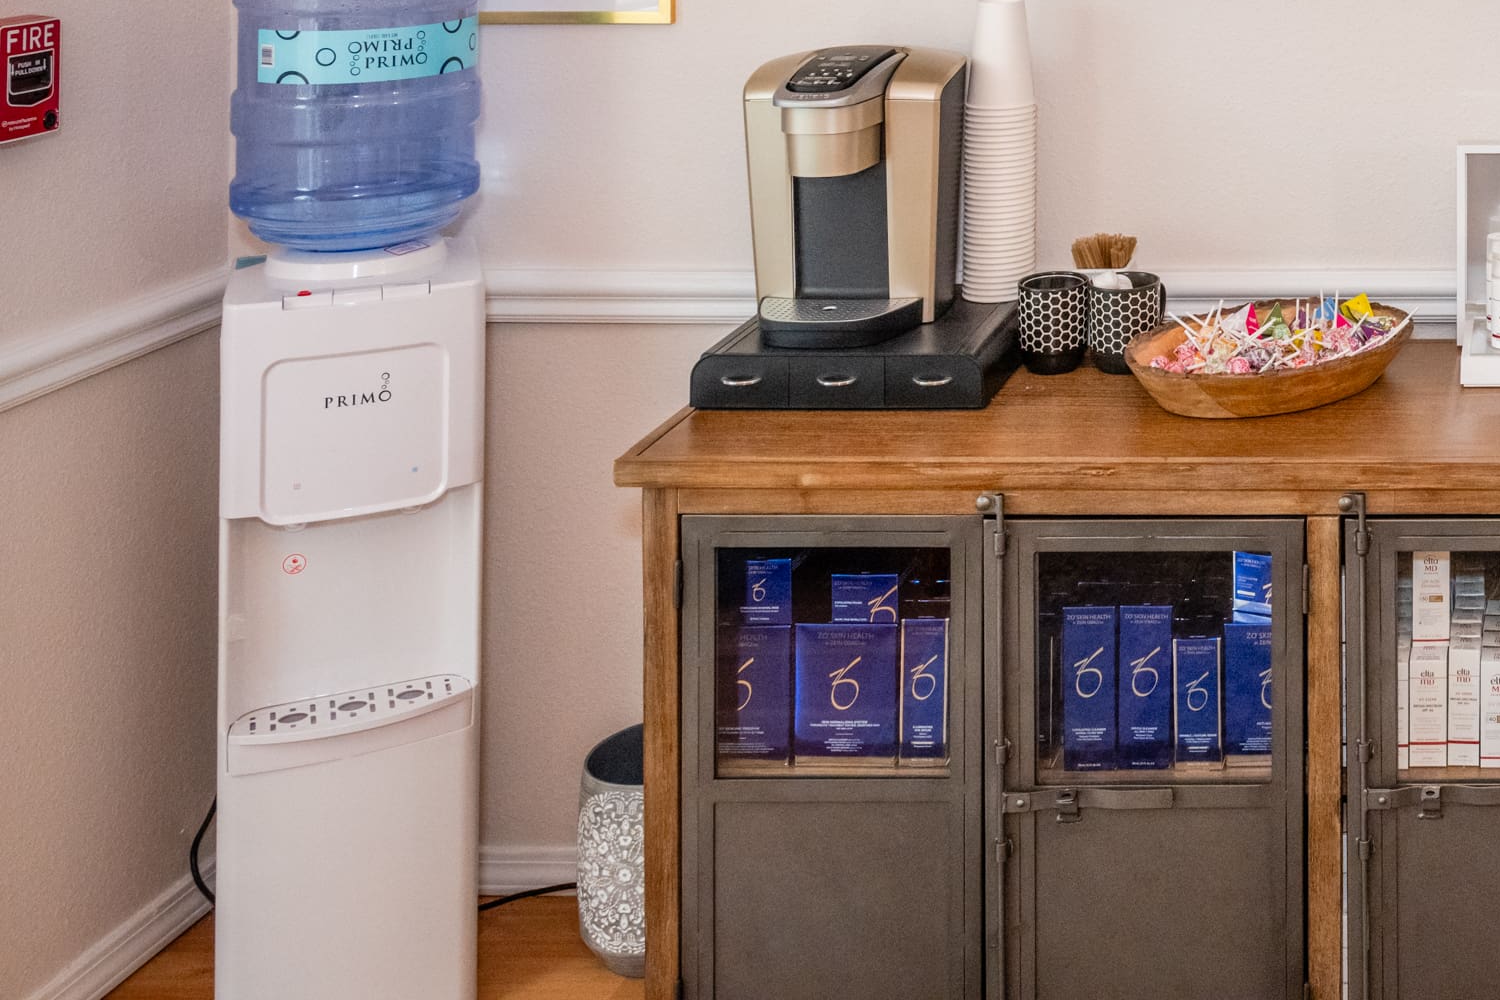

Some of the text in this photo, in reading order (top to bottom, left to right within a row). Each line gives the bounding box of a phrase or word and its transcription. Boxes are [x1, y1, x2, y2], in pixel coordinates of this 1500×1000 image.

[6, 23, 55, 54] FIRE
[348, 38, 413, 54] PRIMO
[366, 52, 428, 69] PRIMO
[325, 390, 392, 409] PRIMO
